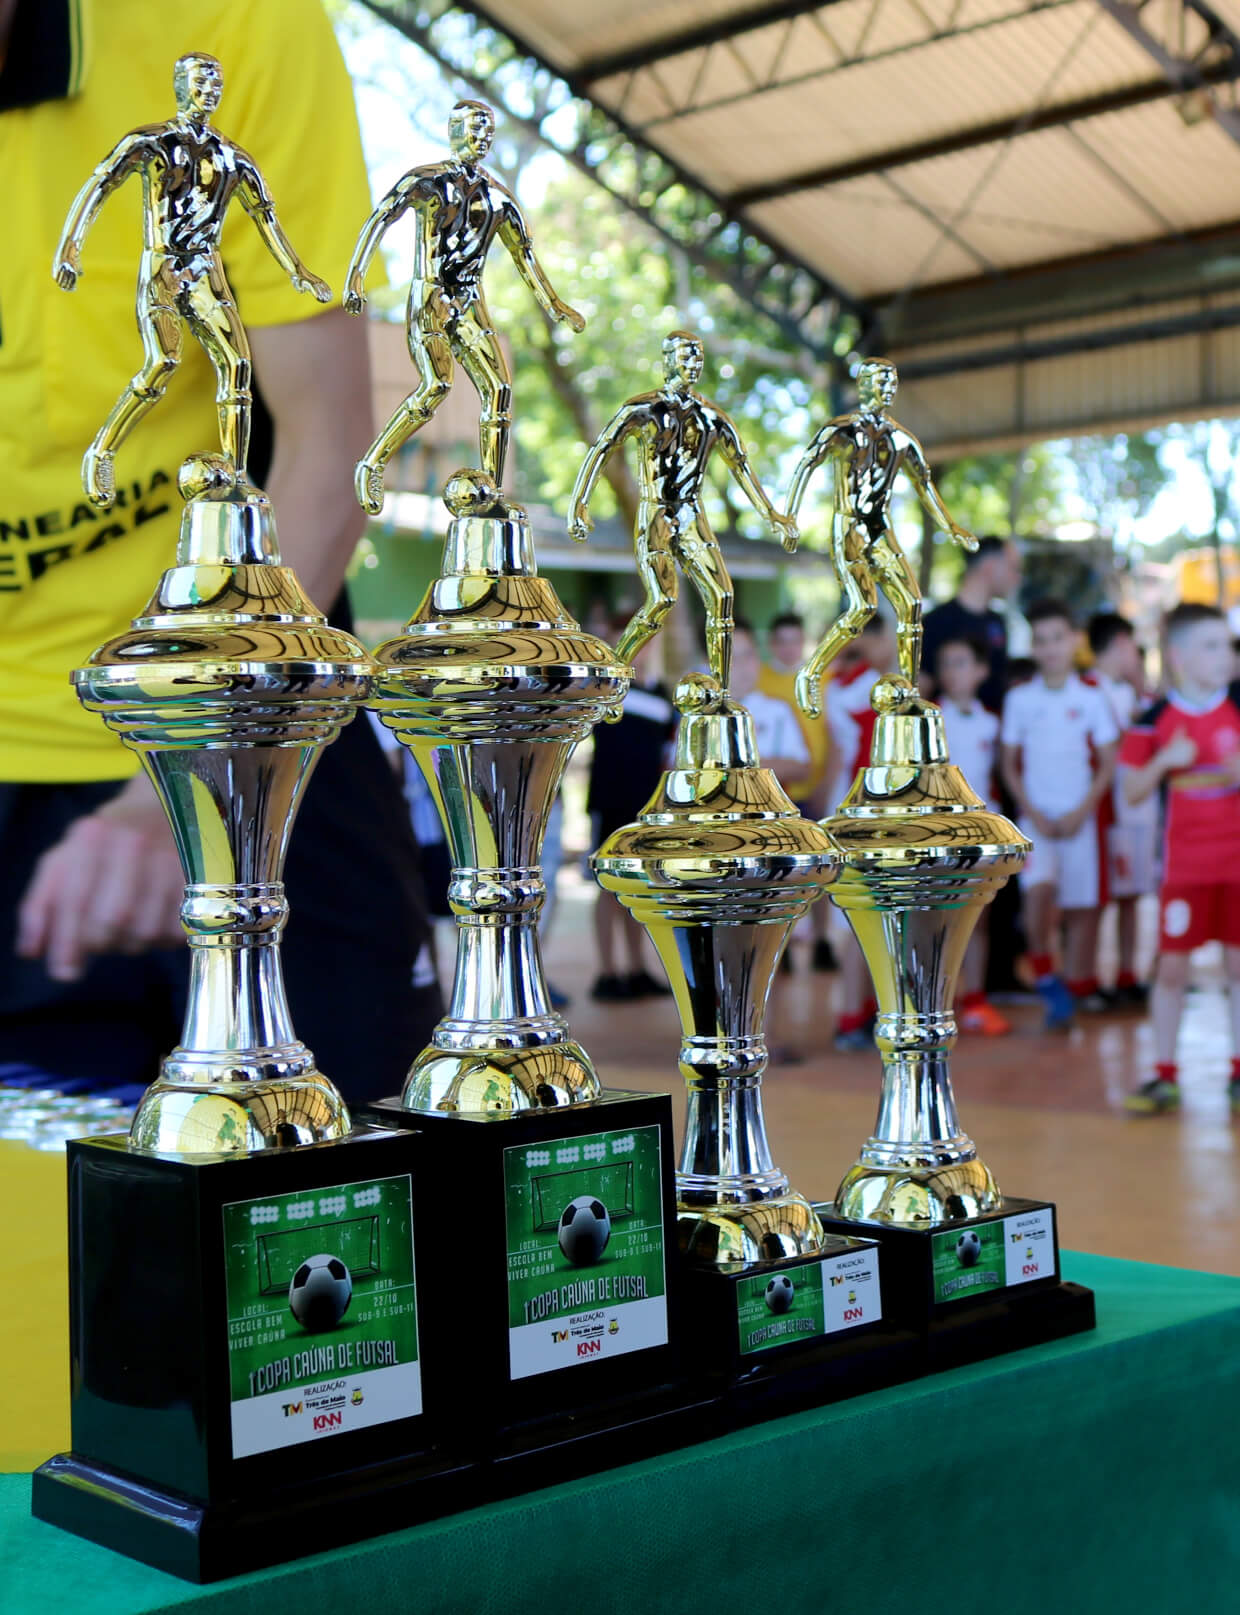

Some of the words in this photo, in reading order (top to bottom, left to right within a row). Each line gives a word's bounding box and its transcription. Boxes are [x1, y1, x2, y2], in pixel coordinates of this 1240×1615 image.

[531, 1288, 559, 1321] COPA
[561, 1277, 596, 1309] CAÚNA
[598, 1276, 611, 1301] DE
[613, 1275, 649, 1299] FUTSAL
[577, 1339, 601, 1356] KNN
[257, 1356, 291, 1393] COPA
[293, 1344, 335, 1379] CAÚNA
[338, 1342, 353, 1369] DE
[355, 1340, 400, 1367] FUTSAL
[313, 1411, 342, 1430] KNN
